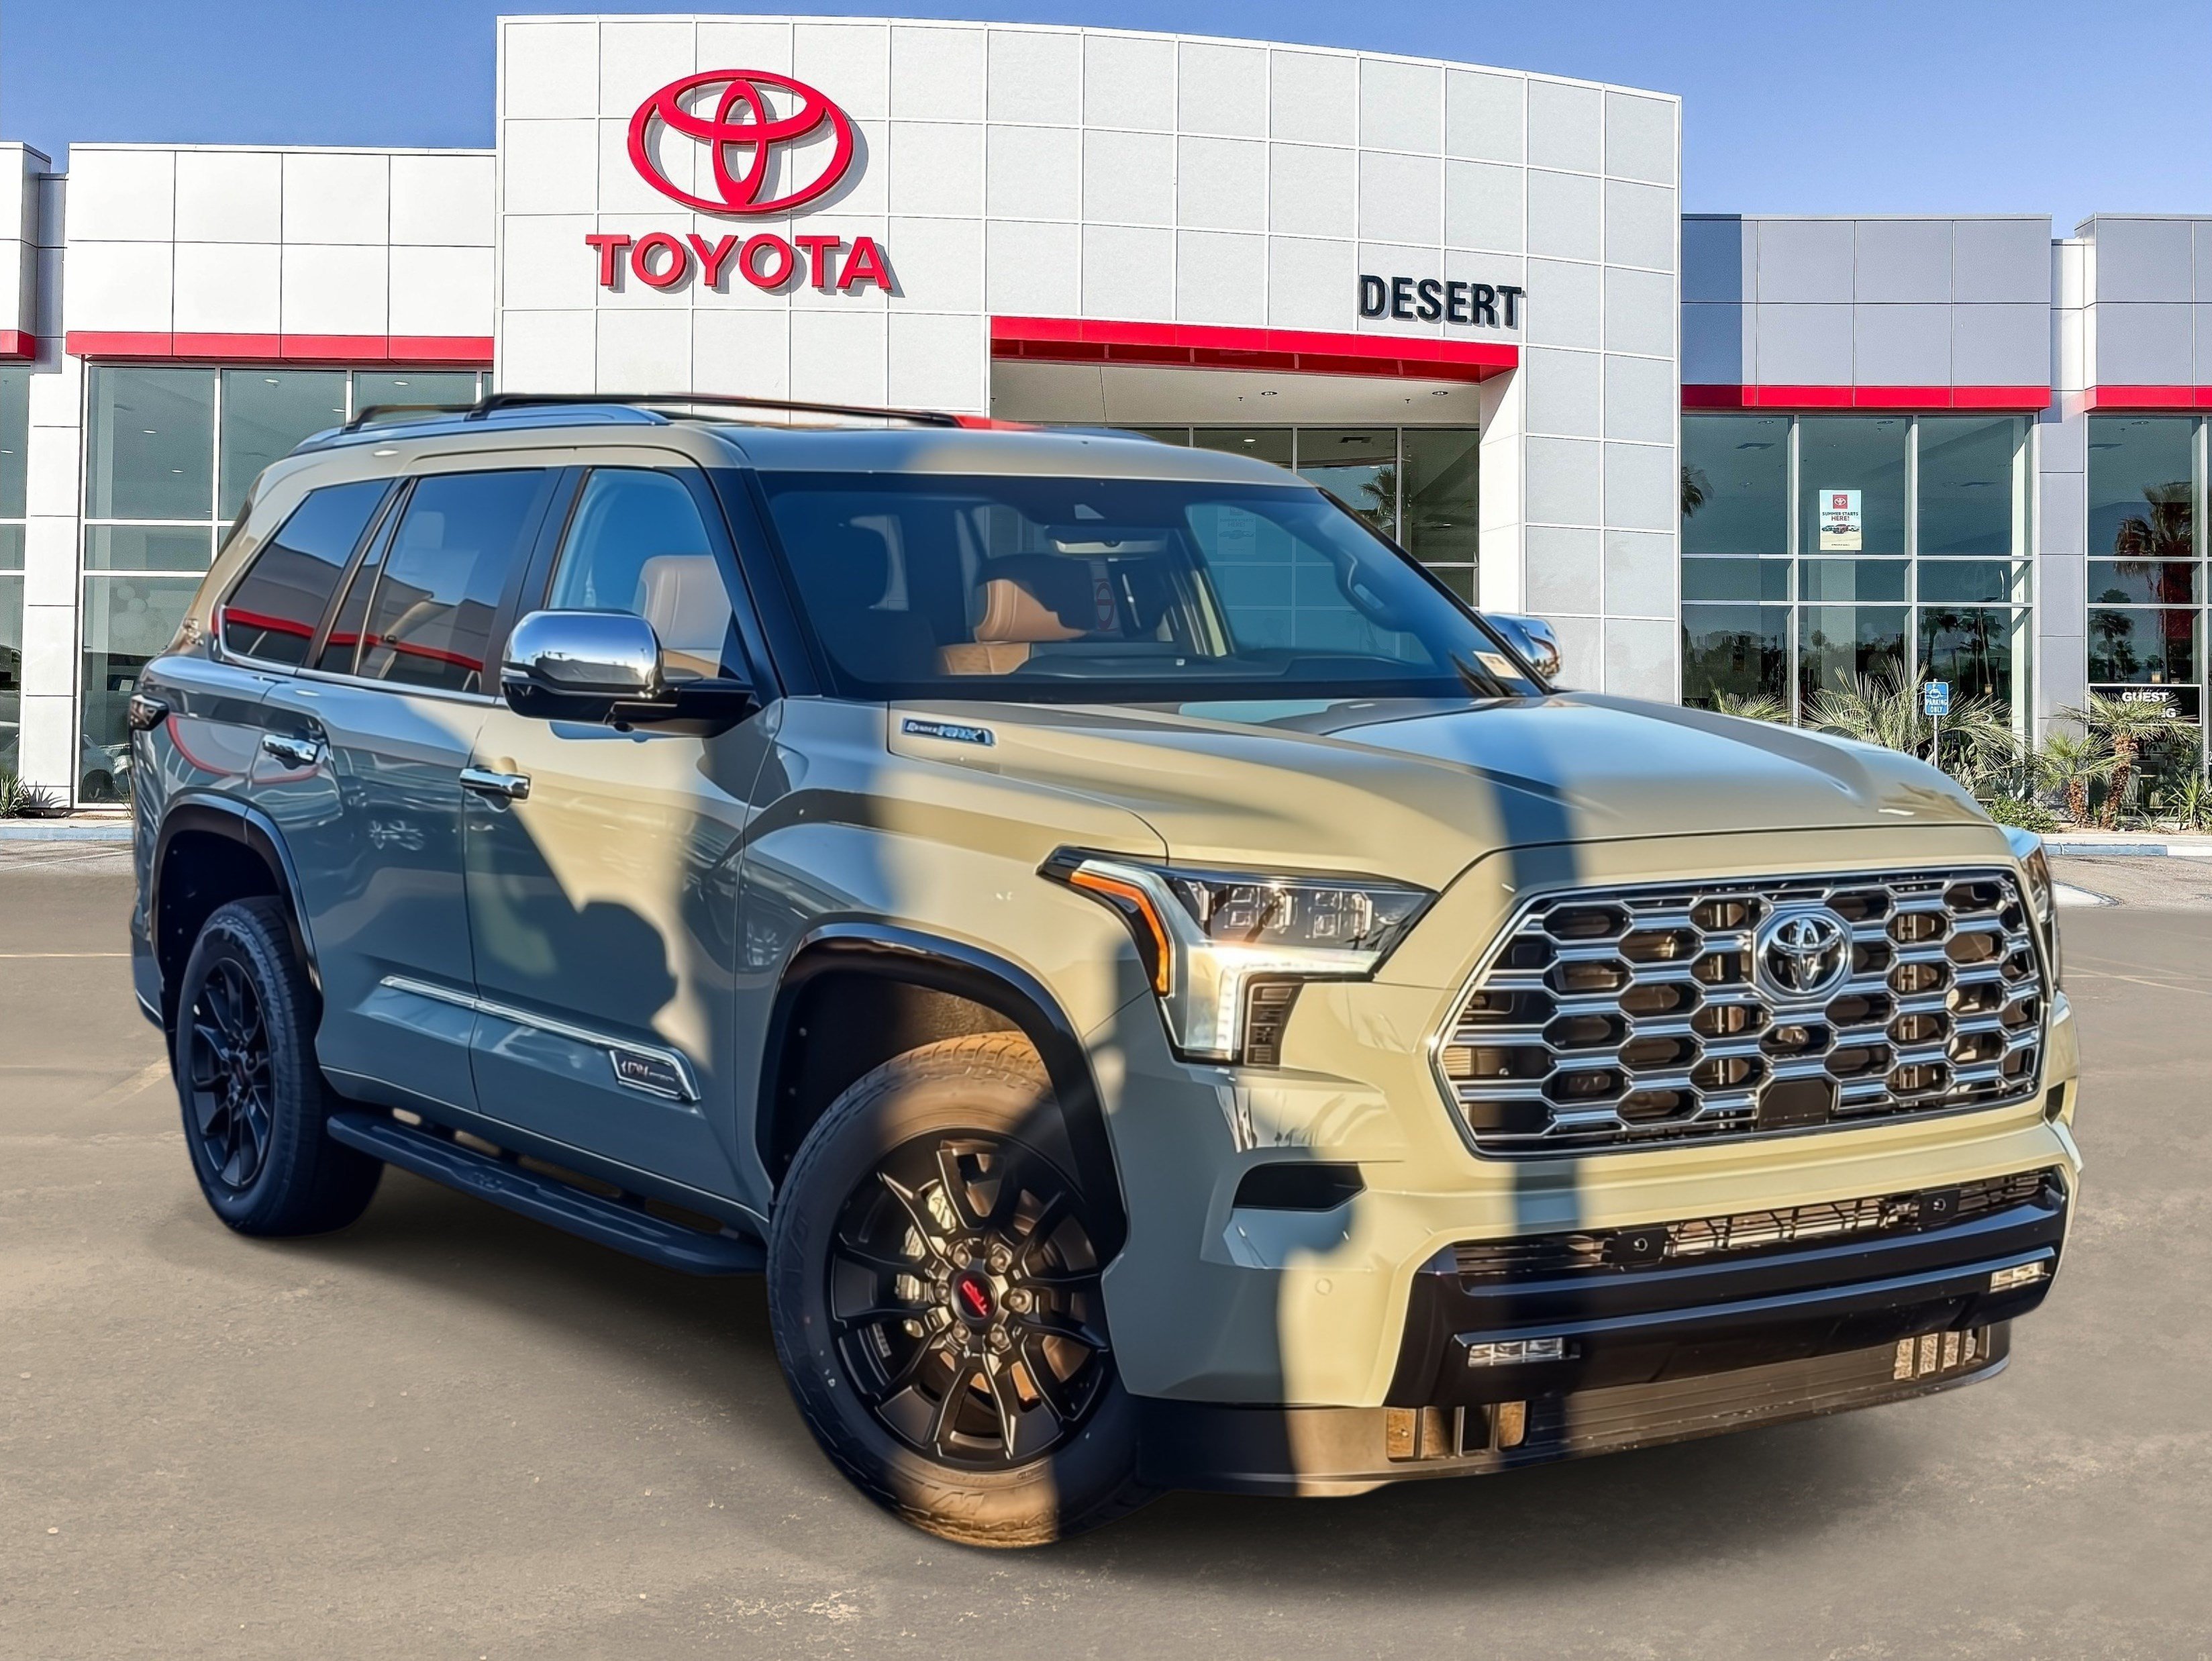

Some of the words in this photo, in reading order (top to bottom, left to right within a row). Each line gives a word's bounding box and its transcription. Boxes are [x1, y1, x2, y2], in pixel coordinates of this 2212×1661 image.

[585, 232, 893, 290] TOYOTA
[1359, 274, 1522, 327] DESERT
[2121, 691, 2169, 703] GUEST
